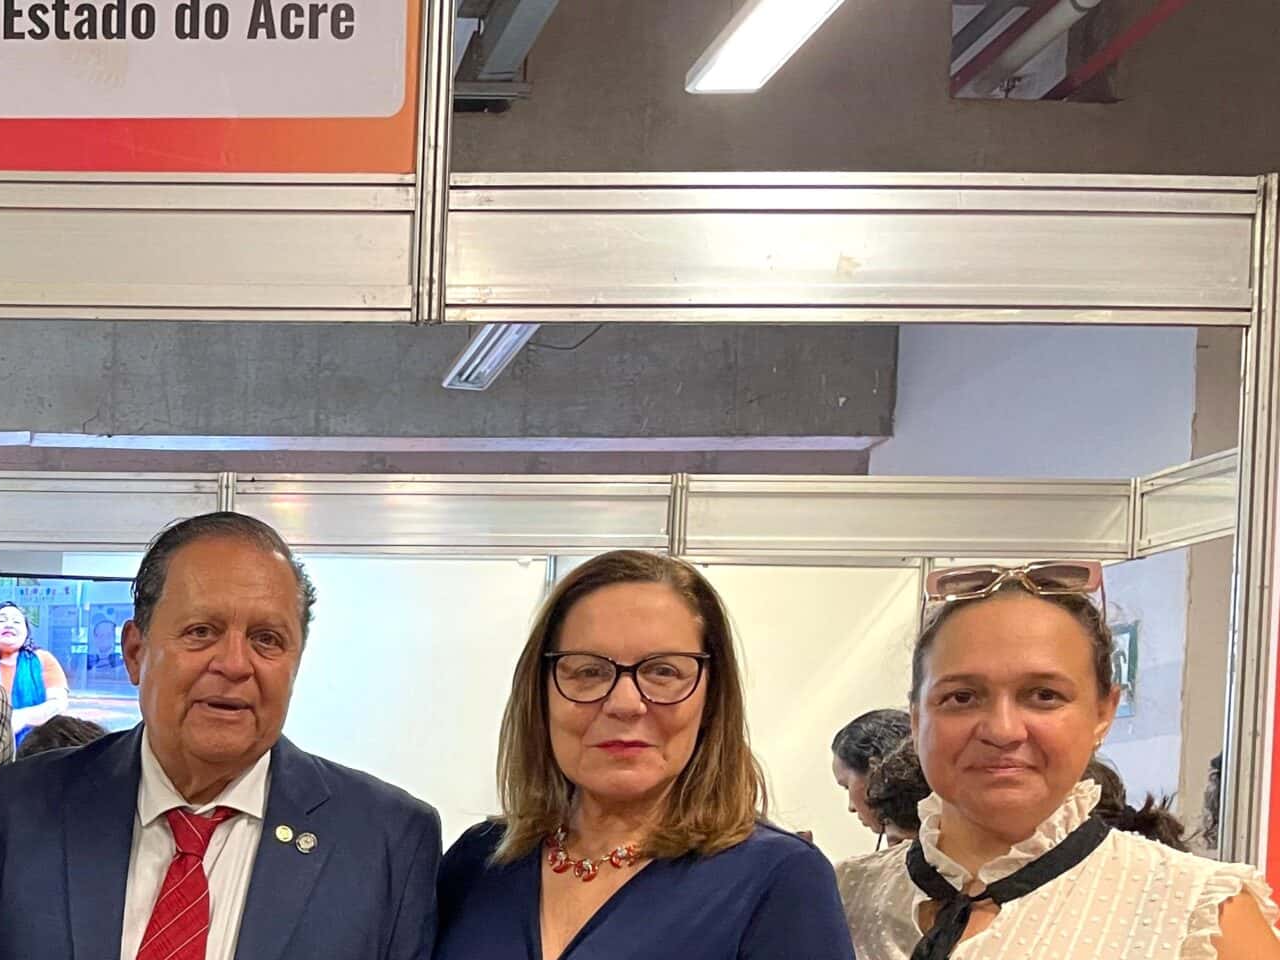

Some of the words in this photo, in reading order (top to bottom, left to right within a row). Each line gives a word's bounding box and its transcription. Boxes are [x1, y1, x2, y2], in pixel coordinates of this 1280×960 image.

[3, 0, 156, 40] Estado
[175, 0, 229, 40] do
[246, 0, 355, 40] Acre
